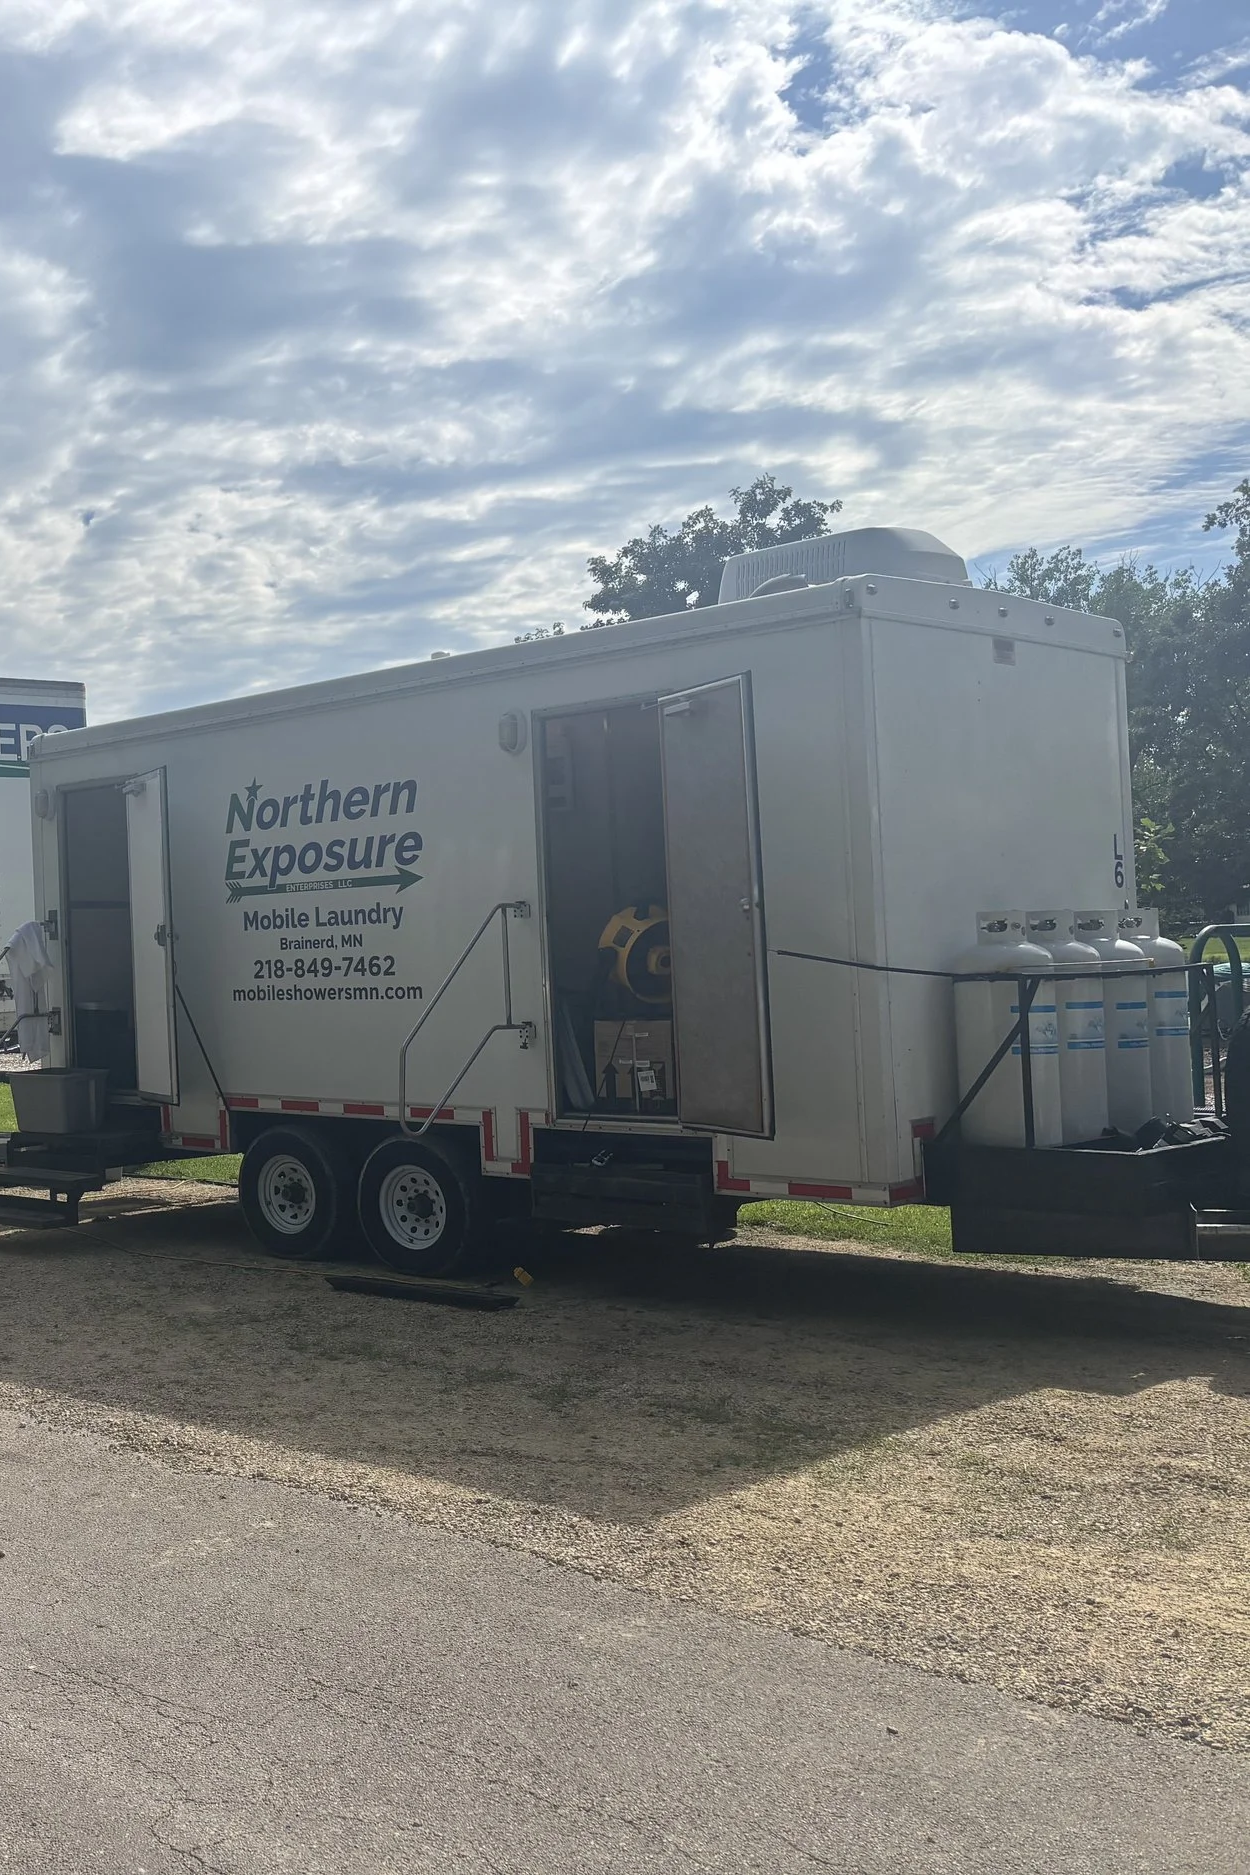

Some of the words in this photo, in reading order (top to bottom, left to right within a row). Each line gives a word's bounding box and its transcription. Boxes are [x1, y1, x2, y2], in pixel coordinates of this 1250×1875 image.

[225, 778, 417, 834] Northern
[225, 831, 423, 890] Exposure
[285, 880, 334, 892] ENTERPRISES
[338, 879, 353, 889] LLC
[243, 907, 309, 931] Mobile
[315, 902, 403, 929] Laundry
[280, 935, 338, 950] Brainerd,
[341, 934, 363, 948] MN
[253, 955, 396, 979] 218-849-7462
[232, 985, 423, 1002] mobileshowersmn.com
